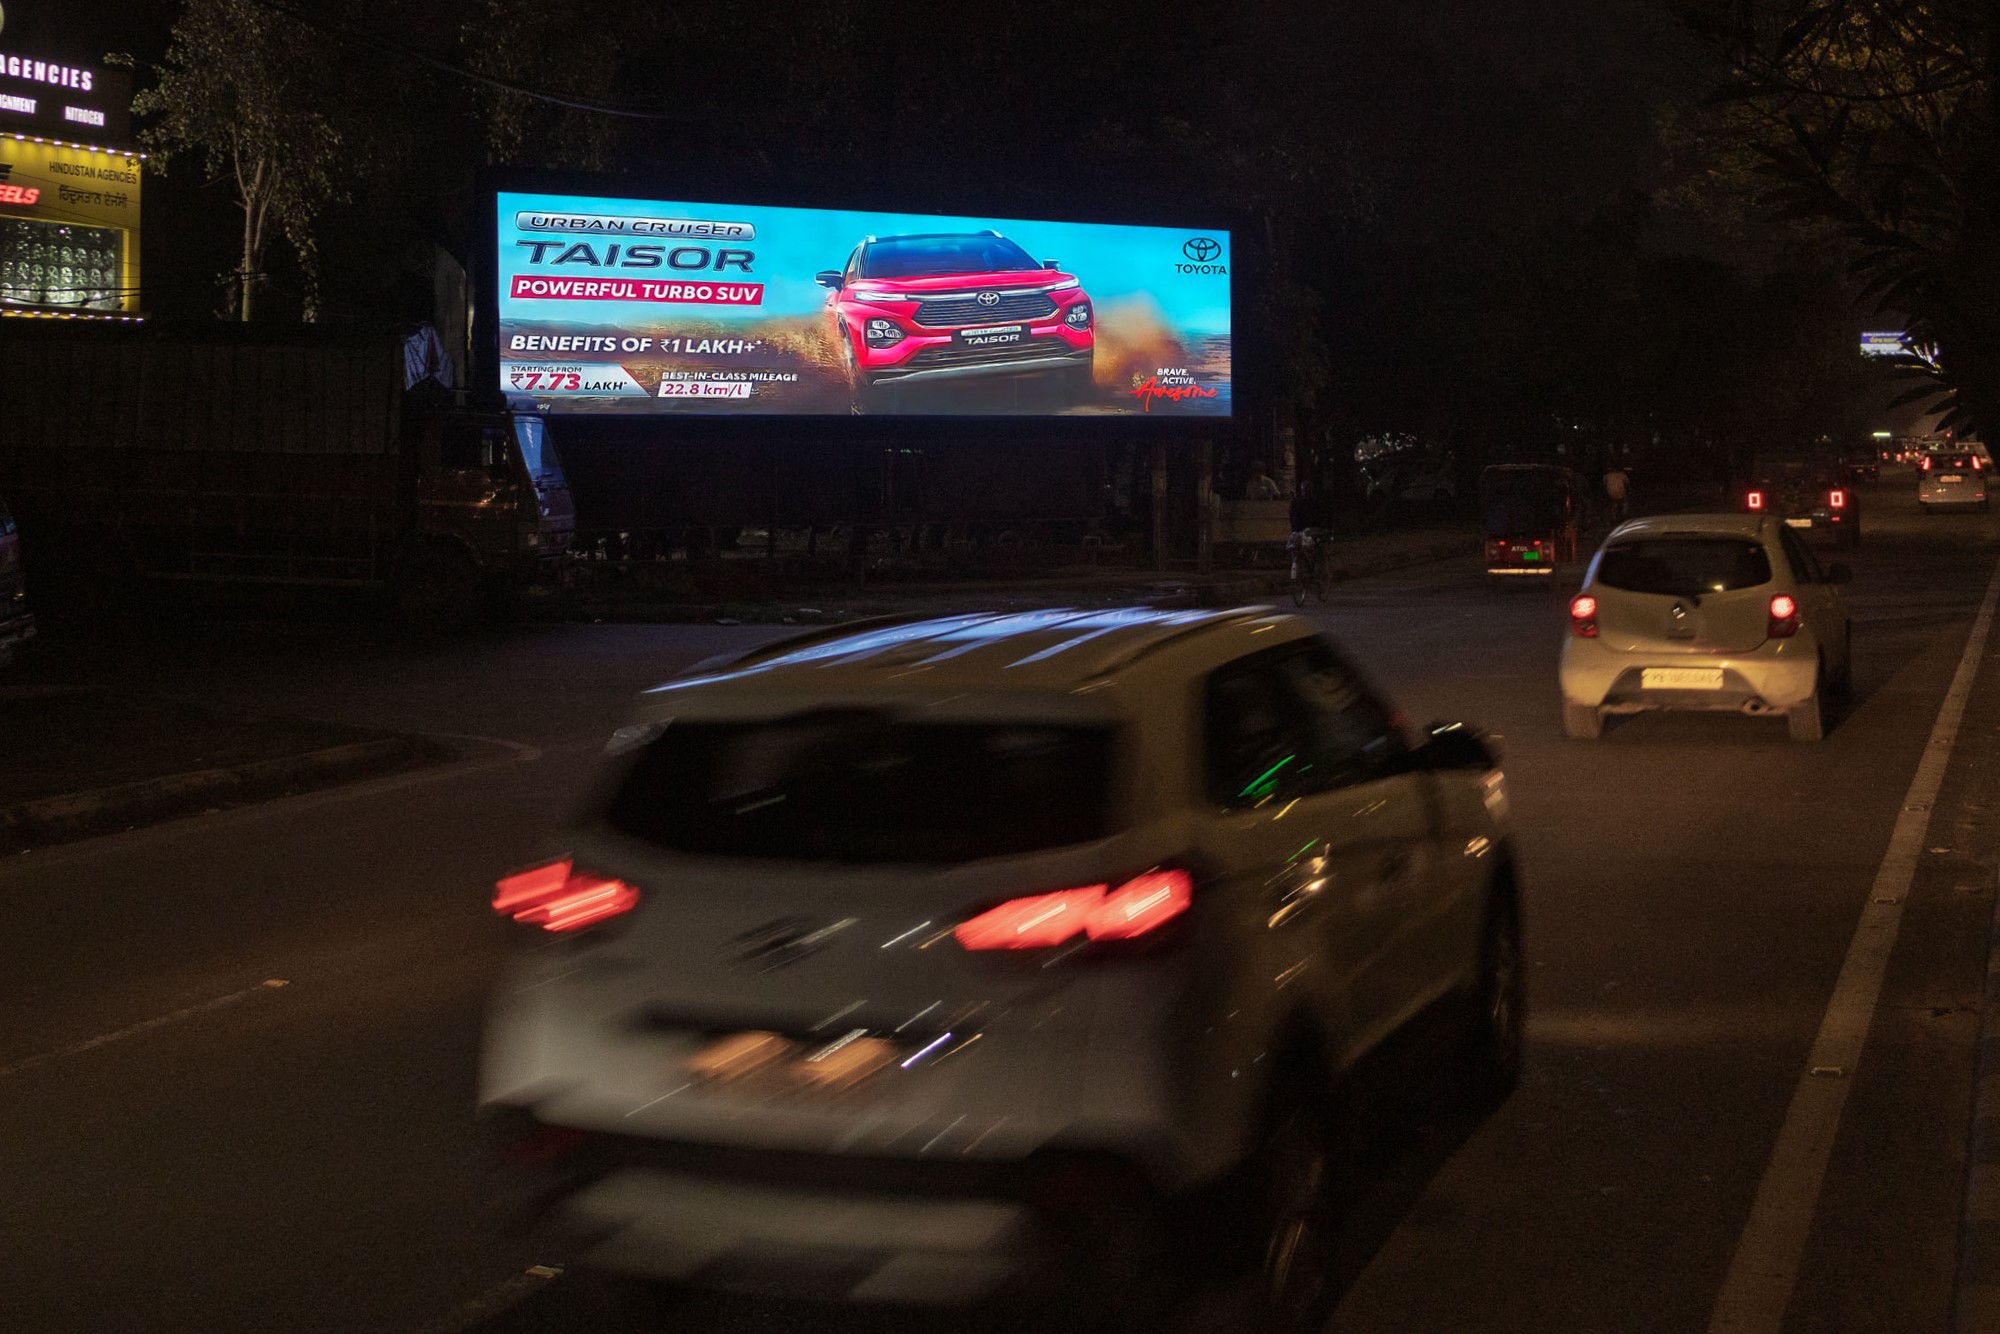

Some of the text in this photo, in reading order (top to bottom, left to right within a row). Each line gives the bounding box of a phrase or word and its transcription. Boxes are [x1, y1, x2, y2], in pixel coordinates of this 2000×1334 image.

[0, 53, 93, 91] AGENCIES
[64, 105, 105, 127] NITROGEN
[49, 161, 137, 184] HINDUSTAN AGENCIES
[531, 216, 743, 237] URBAN CRUISER
[515, 239, 756, 273] TAISOR
[1174, 264, 1227, 275] TOYOTA
[516, 279, 759, 302] POWERFUL TURBO SUV
[510, 335, 617, 352] BENEFITS
[621, 337, 653, 353] OF
[964, 334, 1020, 345] TAISOR
[510, 365, 554, 373] STARTING
[662, 371, 798, 382] BEST-IN-CLASS MILEAGE
[1156, 368, 1189, 376] BRAVE.
[1161, 377, 1196, 385] ACTIVE.
[664, 383, 699, 395] 22.8
